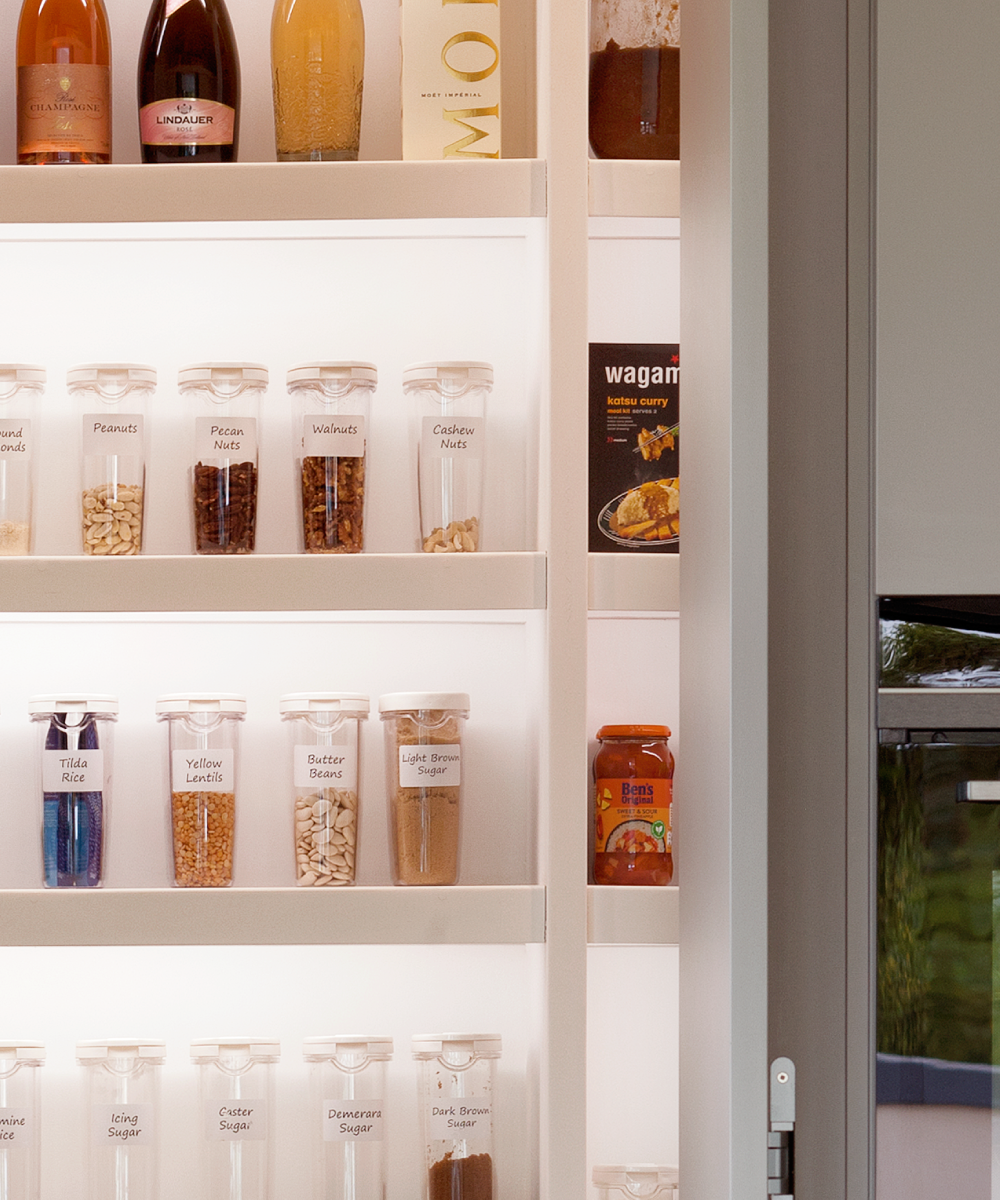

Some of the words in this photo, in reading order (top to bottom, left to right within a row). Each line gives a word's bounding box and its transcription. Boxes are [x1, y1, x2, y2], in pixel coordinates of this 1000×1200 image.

[441, 0, 500, 159] MO
[30, 104, 100, 112] CHAMPAGNE
[156, 116, 213, 124] LINDAUER
[606, 396, 638, 406] katsu
[639, 398, 669, 408] curry
[94, 423, 137, 433] Peanuts
[211, 426, 244, 435] Pecan
[313, 423, 357, 434] Walnuts
[433, 424, 474, 435] Cashew
[214, 440, 240, 450] Nuts
[441, 439, 467, 449] Nuts
[59, 758, 87, 768] Tilda
[186, 758, 222, 769] Yellow
[308, 754, 345, 764] Butter
[403, 753, 427, 765] Light
[431, 754, 459, 762] Brown
[310, 768, 342, 778] Beans
[418, 766, 447, 777] Sugar
[62, 772, 85, 782] Rice
[187, 772, 222, 782] Lentils
[621, 782, 654, 796] Ben's
[621, 796, 654, 805] Original
[329, 1110, 381, 1119] Demerara
[433, 1106, 455, 1116] Dark
[460, 1106, 490, 1116] Brown
[112, 1112, 138, 1126] Icing
[447, 1118, 477, 1130] Sugar
[108, 1127, 141, 1140] Sugar
[340, 1123, 373, 1136] Sugar
